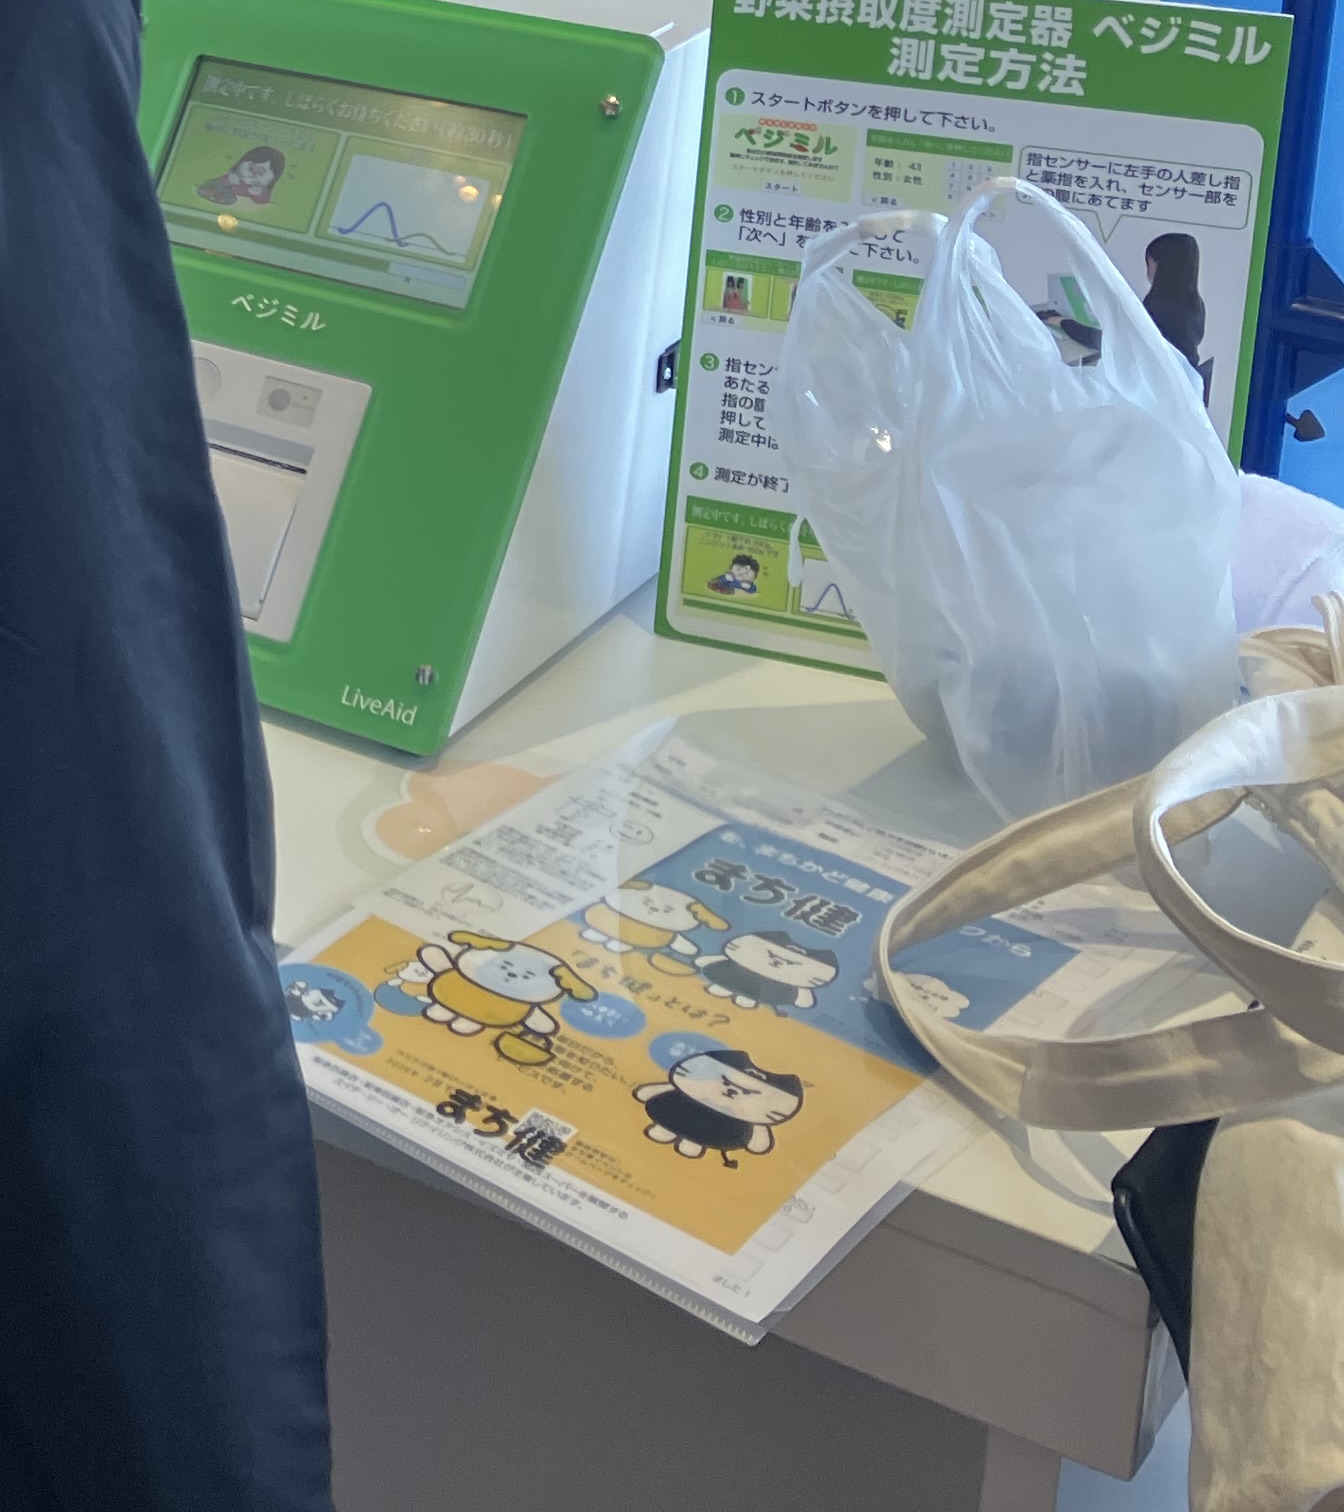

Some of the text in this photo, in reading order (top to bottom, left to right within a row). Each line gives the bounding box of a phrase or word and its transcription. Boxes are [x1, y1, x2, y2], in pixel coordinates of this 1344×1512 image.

[1092, 14, 1272, 65] ベジミル
[887, 37, 1088, 97] 測定方法
[751, 90, 996, 133] スタートボタンを押して下さい。
[734, 126, 839, 156] ベジミル
[764, 181, 799, 193] スタート
[1025, 170, 1238, 207] と薬指を入れ、センサー部を
[1026, 151, 1241, 191] 指センサーに左手の人差し指
[231, 293, 327, 332] ベジミル
[723, 375, 770, 396] あたる
[725, 356, 779, 377] 指セン
[719, 409, 767, 431] 押して
[340, 684, 418, 727] LiveAid
[693, 856, 863, 938] まち健
[435, 1087, 568, 1170] まち健
